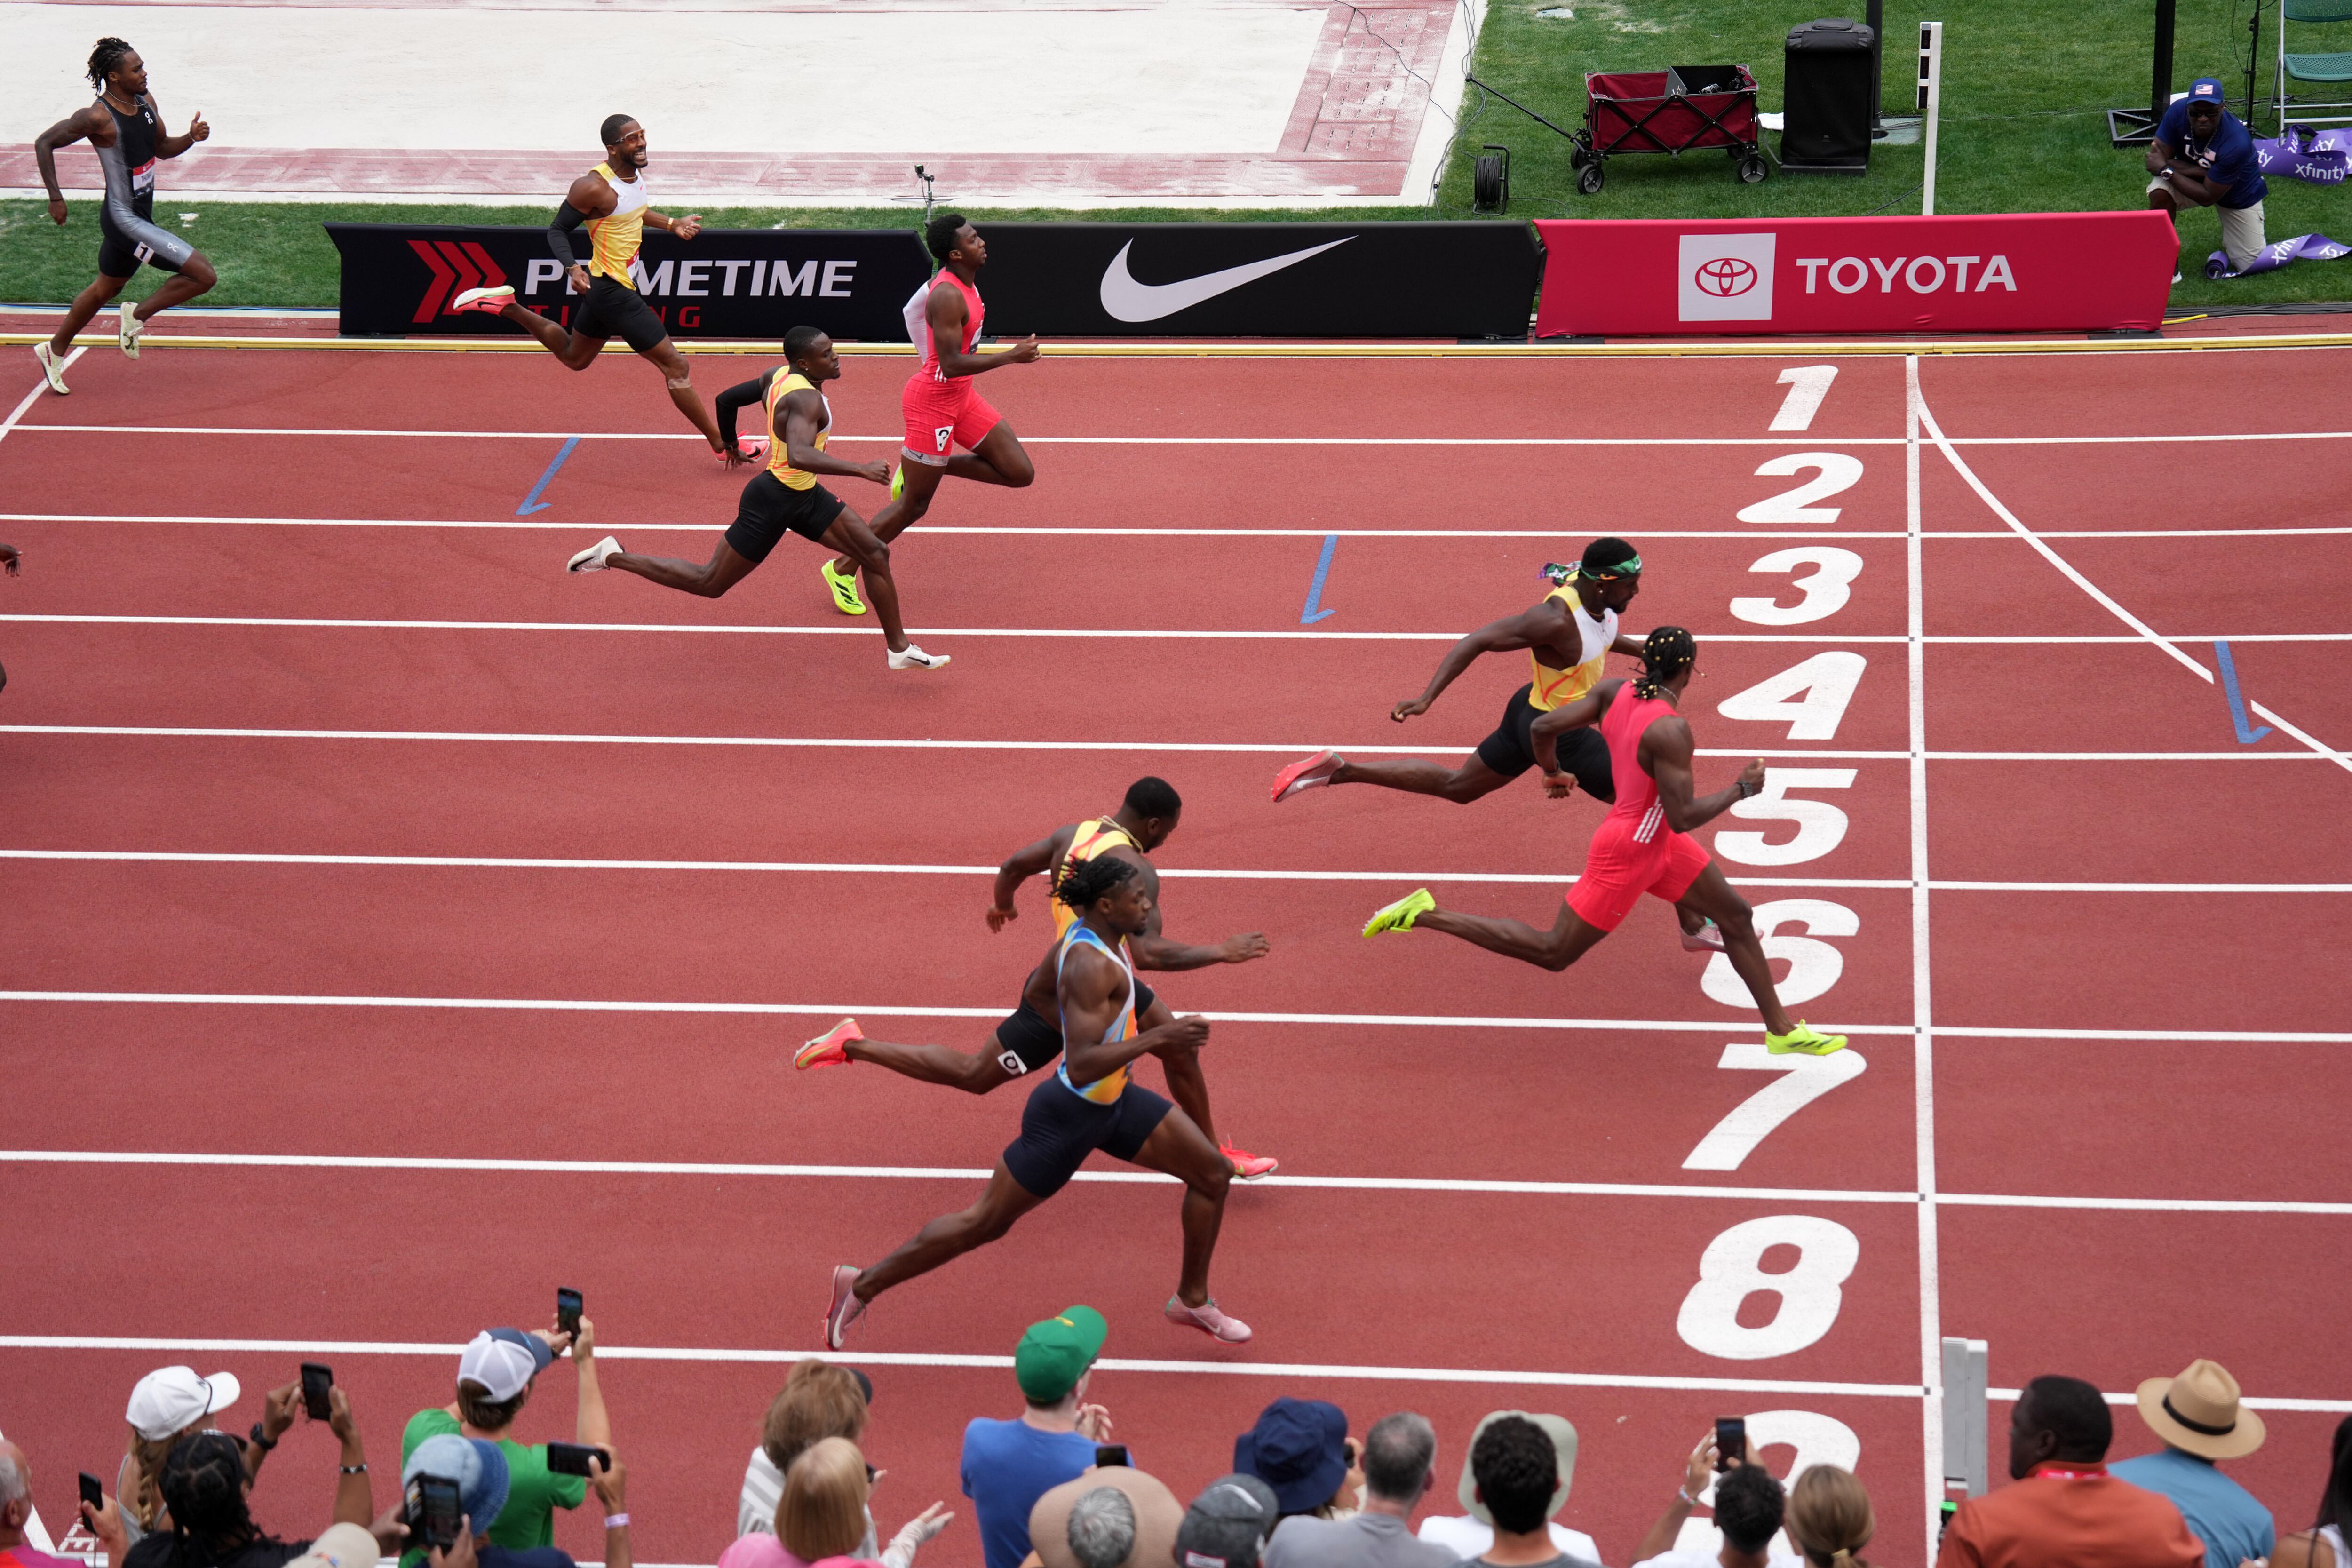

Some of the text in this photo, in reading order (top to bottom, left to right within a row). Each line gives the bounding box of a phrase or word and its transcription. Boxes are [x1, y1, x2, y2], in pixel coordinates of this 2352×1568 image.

[2295, 163, 2347, 181] xfinity
[1796, 255, 2017, 294] TOYOTA
[1768, 365, 1839, 431] 1
[1736, 452, 1864, 523] 2
[1730, 546, 1864, 625] 3
[1717, 651, 1867, 740] 4
[1714, 768, 1859, 866] 5
[1700, 899, 1860, 1009] 6
[1681, 1043, 1867, 1170] 7
[1676, 1215, 1859, 1360] 8
